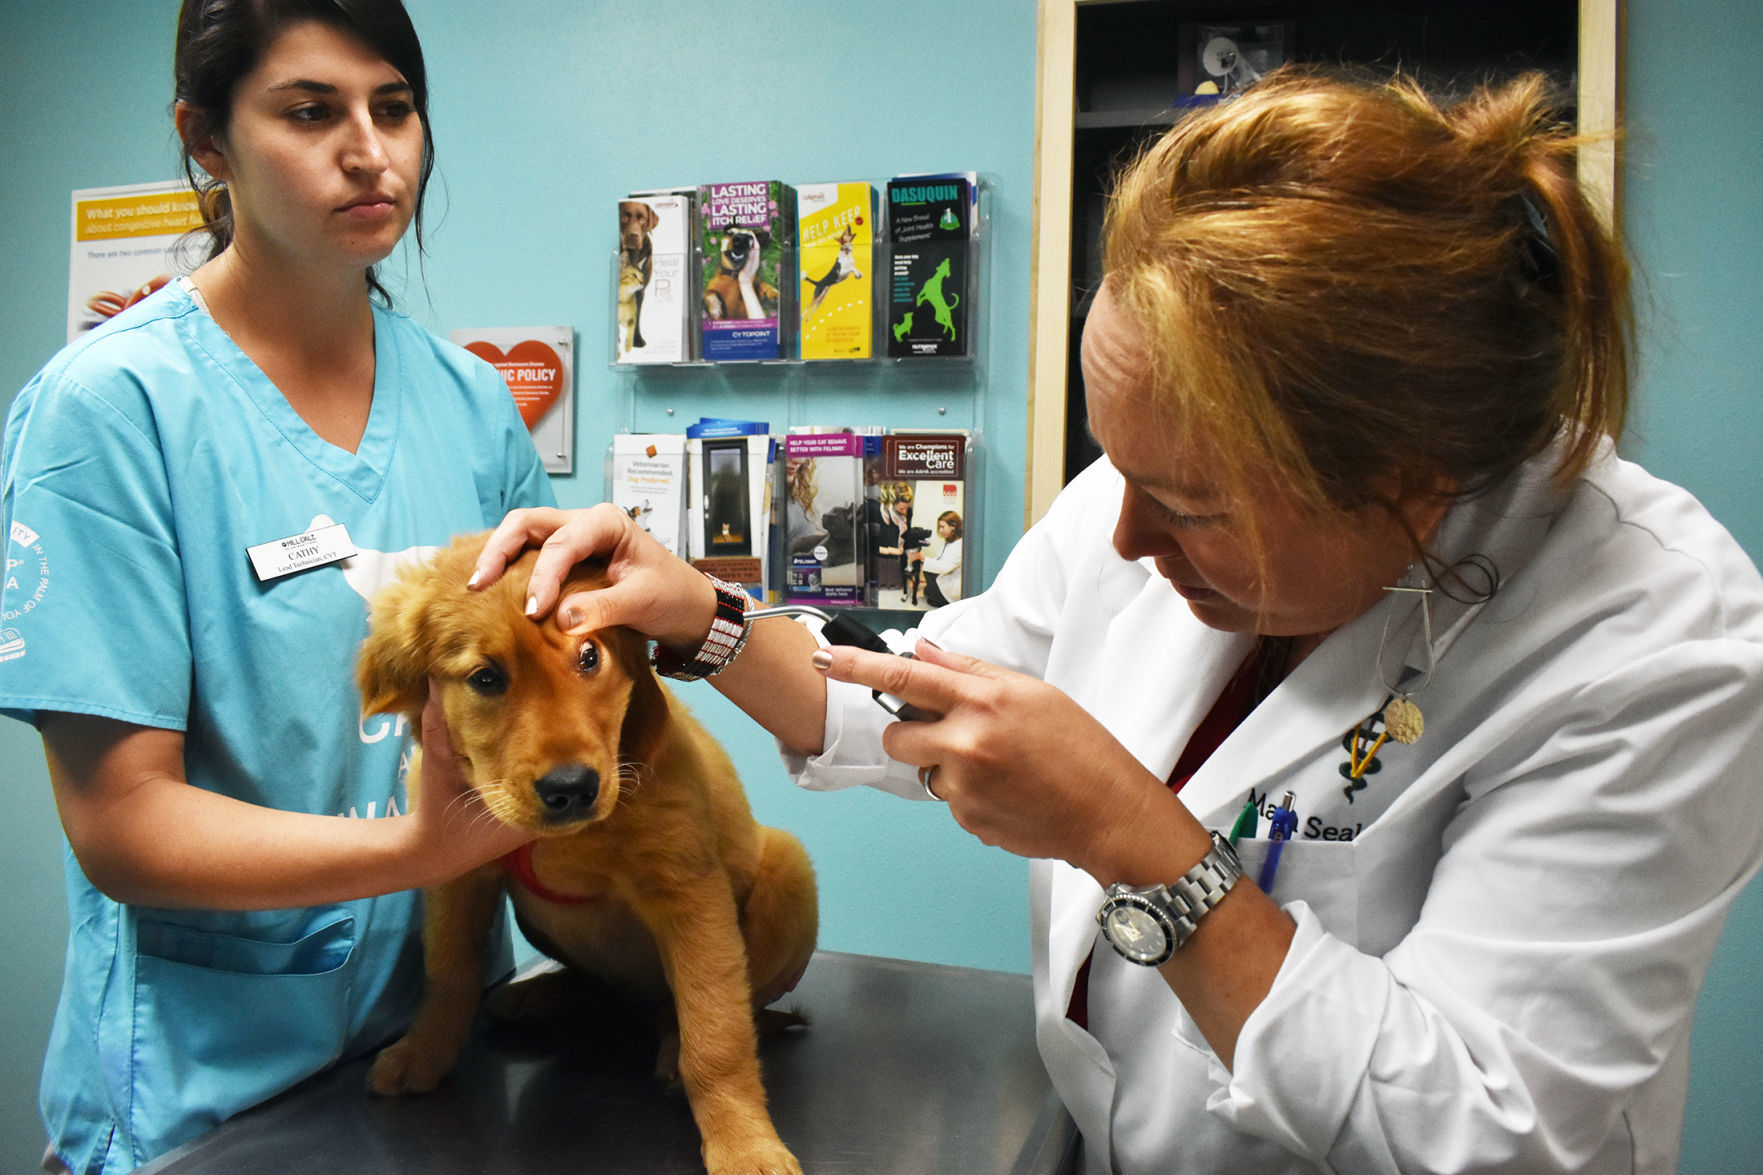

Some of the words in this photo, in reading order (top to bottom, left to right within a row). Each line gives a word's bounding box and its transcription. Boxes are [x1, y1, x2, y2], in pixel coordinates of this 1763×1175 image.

[712, 184, 766, 198] LASTING
[891, 185, 958, 203] DASUQUIN
[86, 208, 113, 219] What
[116, 208, 134, 219] you
[136, 203, 169, 216] should
[712, 203, 766, 216] LASTING
[713, 216, 734, 226] ITCH
[735, 214, 766, 224] RELIEF
[802, 219, 829, 242] HELP
[833, 205, 861, 230] KEEP
[517, 368, 556, 381] POLICY
[915, 443, 947, 451] Champions
[898, 449, 954, 460] Excellent
[926, 459, 955, 469] Care
[32, 543, 44, 555] IN
[288, 546, 319, 561] CATHY
[39, 556, 50, 576] THE
[278, 564, 293, 573] Lead
[323, 551, 337, 560] CVT
[33, 577, 49, 602] PALM
[23, 599, 37, 613] OF
